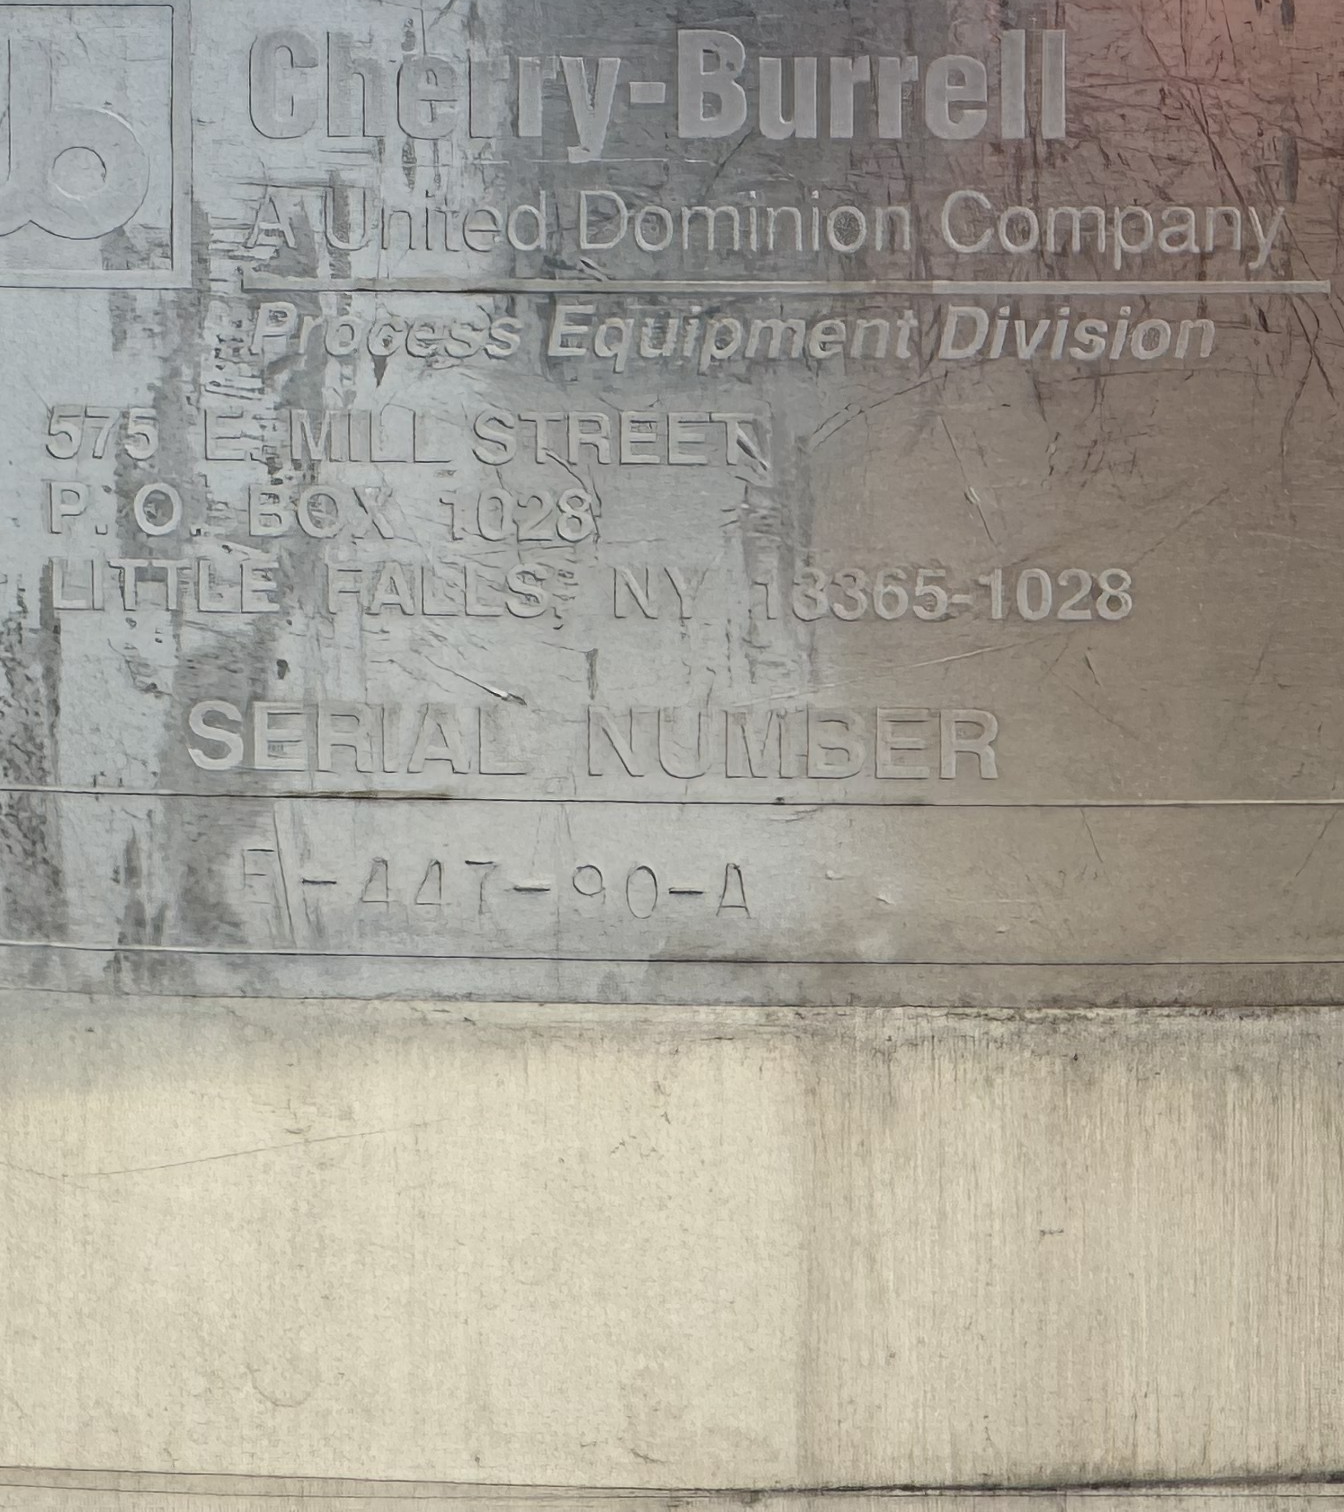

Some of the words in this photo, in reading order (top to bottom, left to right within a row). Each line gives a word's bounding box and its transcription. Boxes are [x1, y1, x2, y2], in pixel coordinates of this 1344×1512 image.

[247, 28, 1068, 164] Cherry-Burrell
[245, 188, 298, 251] A
[324, 187, 548, 252] United
[578, 190, 913, 254] Dominion
[940, 190, 1286, 271] Company
[252, 301, 523, 360] Process
[547, 303, 920, 375] Equipment
[937, 305, 1217, 362] Division
[45, 404, 159, 461] 575
[288, 406, 454, 464] MILL
[471, 407, 760, 467] STREET
[248, 484, 396, 540] BOX
[440, 487, 596, 544] 1028
[50, 557, 282, 614] LITTLE
[612, 565, 711, 620] NY
[752, 566, 1135, 623] 13365-1028
[187, 700, 529, 778] SERIAL
[585, 702, 1001, 782] NUMBER
